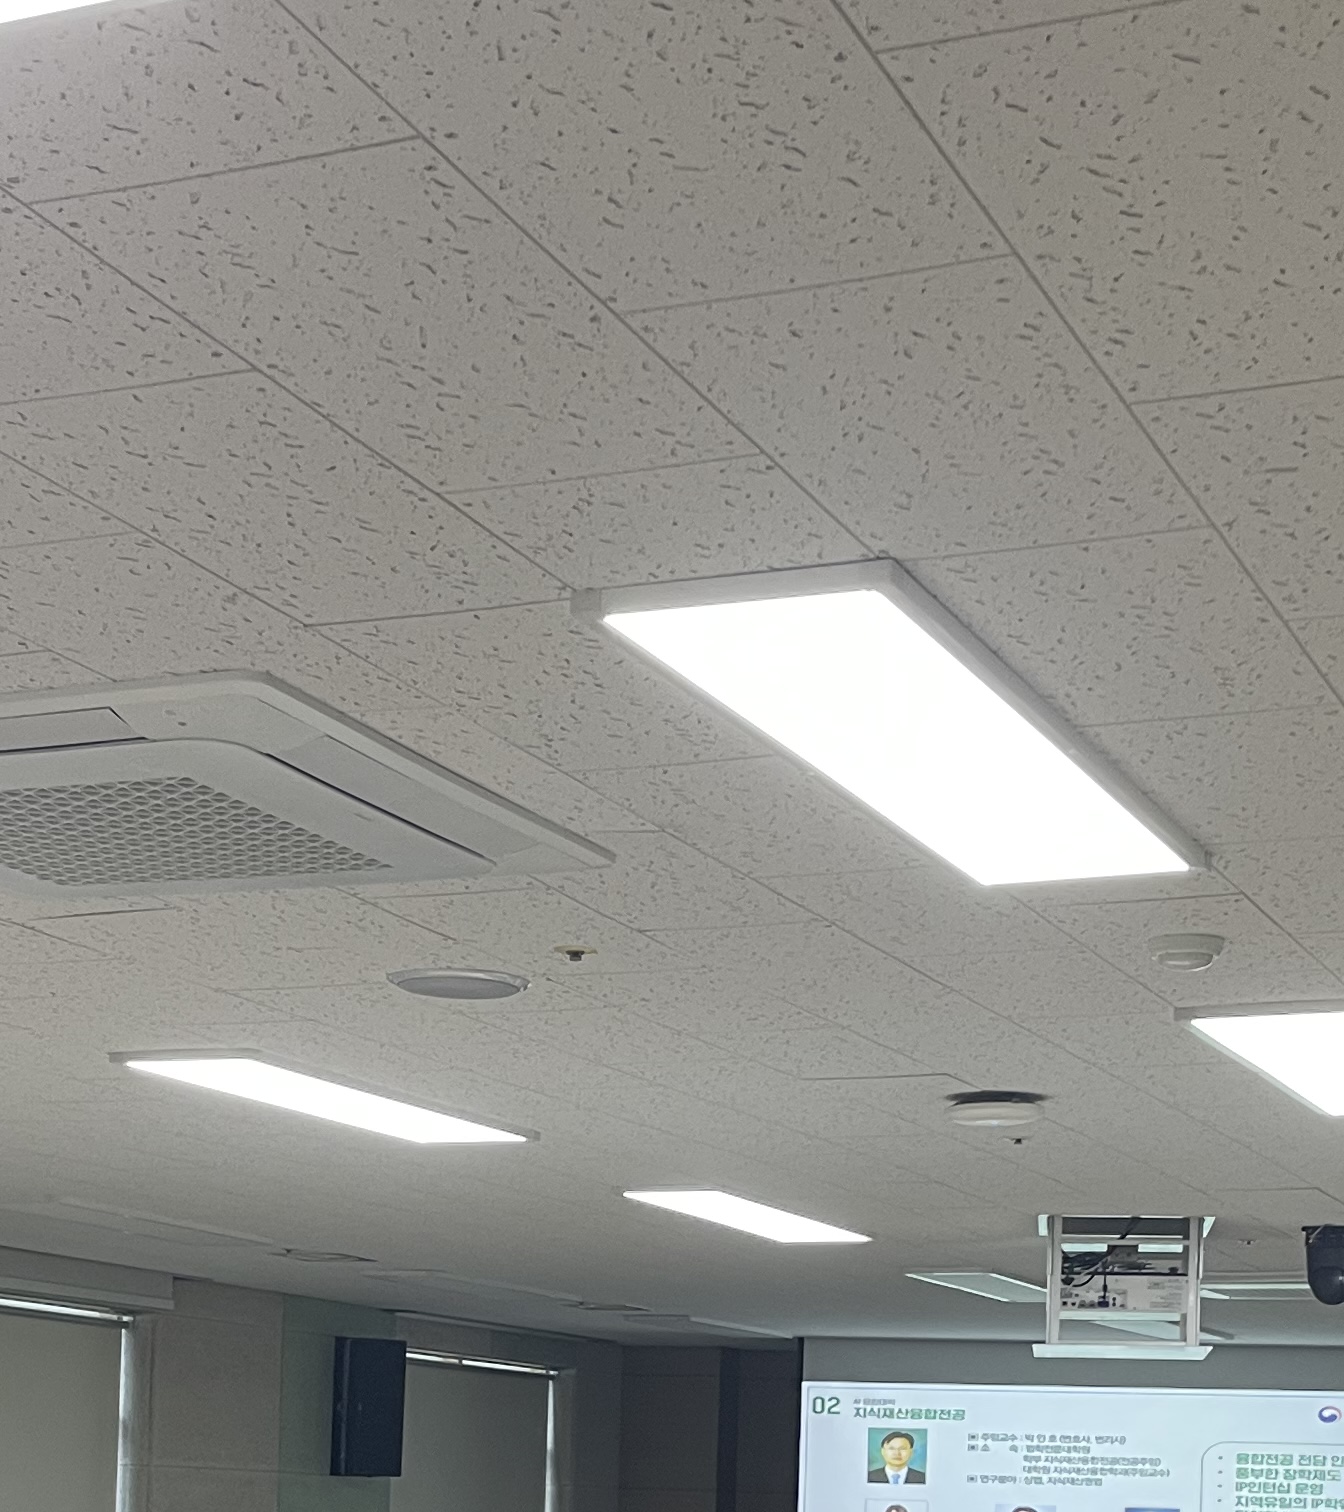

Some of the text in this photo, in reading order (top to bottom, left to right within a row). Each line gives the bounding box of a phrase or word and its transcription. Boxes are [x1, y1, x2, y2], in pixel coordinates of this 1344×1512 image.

[812, 1396, 841, 1415] 02
[853, 1407, 966, 1421] 지식재산융합전공
[1298, 1454, 1327, 1467] 전담
[1282, 1468, 1342, 1482] 장학제도
[1235, 1482, 1324, 1496] IP인턴십 운영
[1235, 1496, 1306, 1510] 지역유일의
